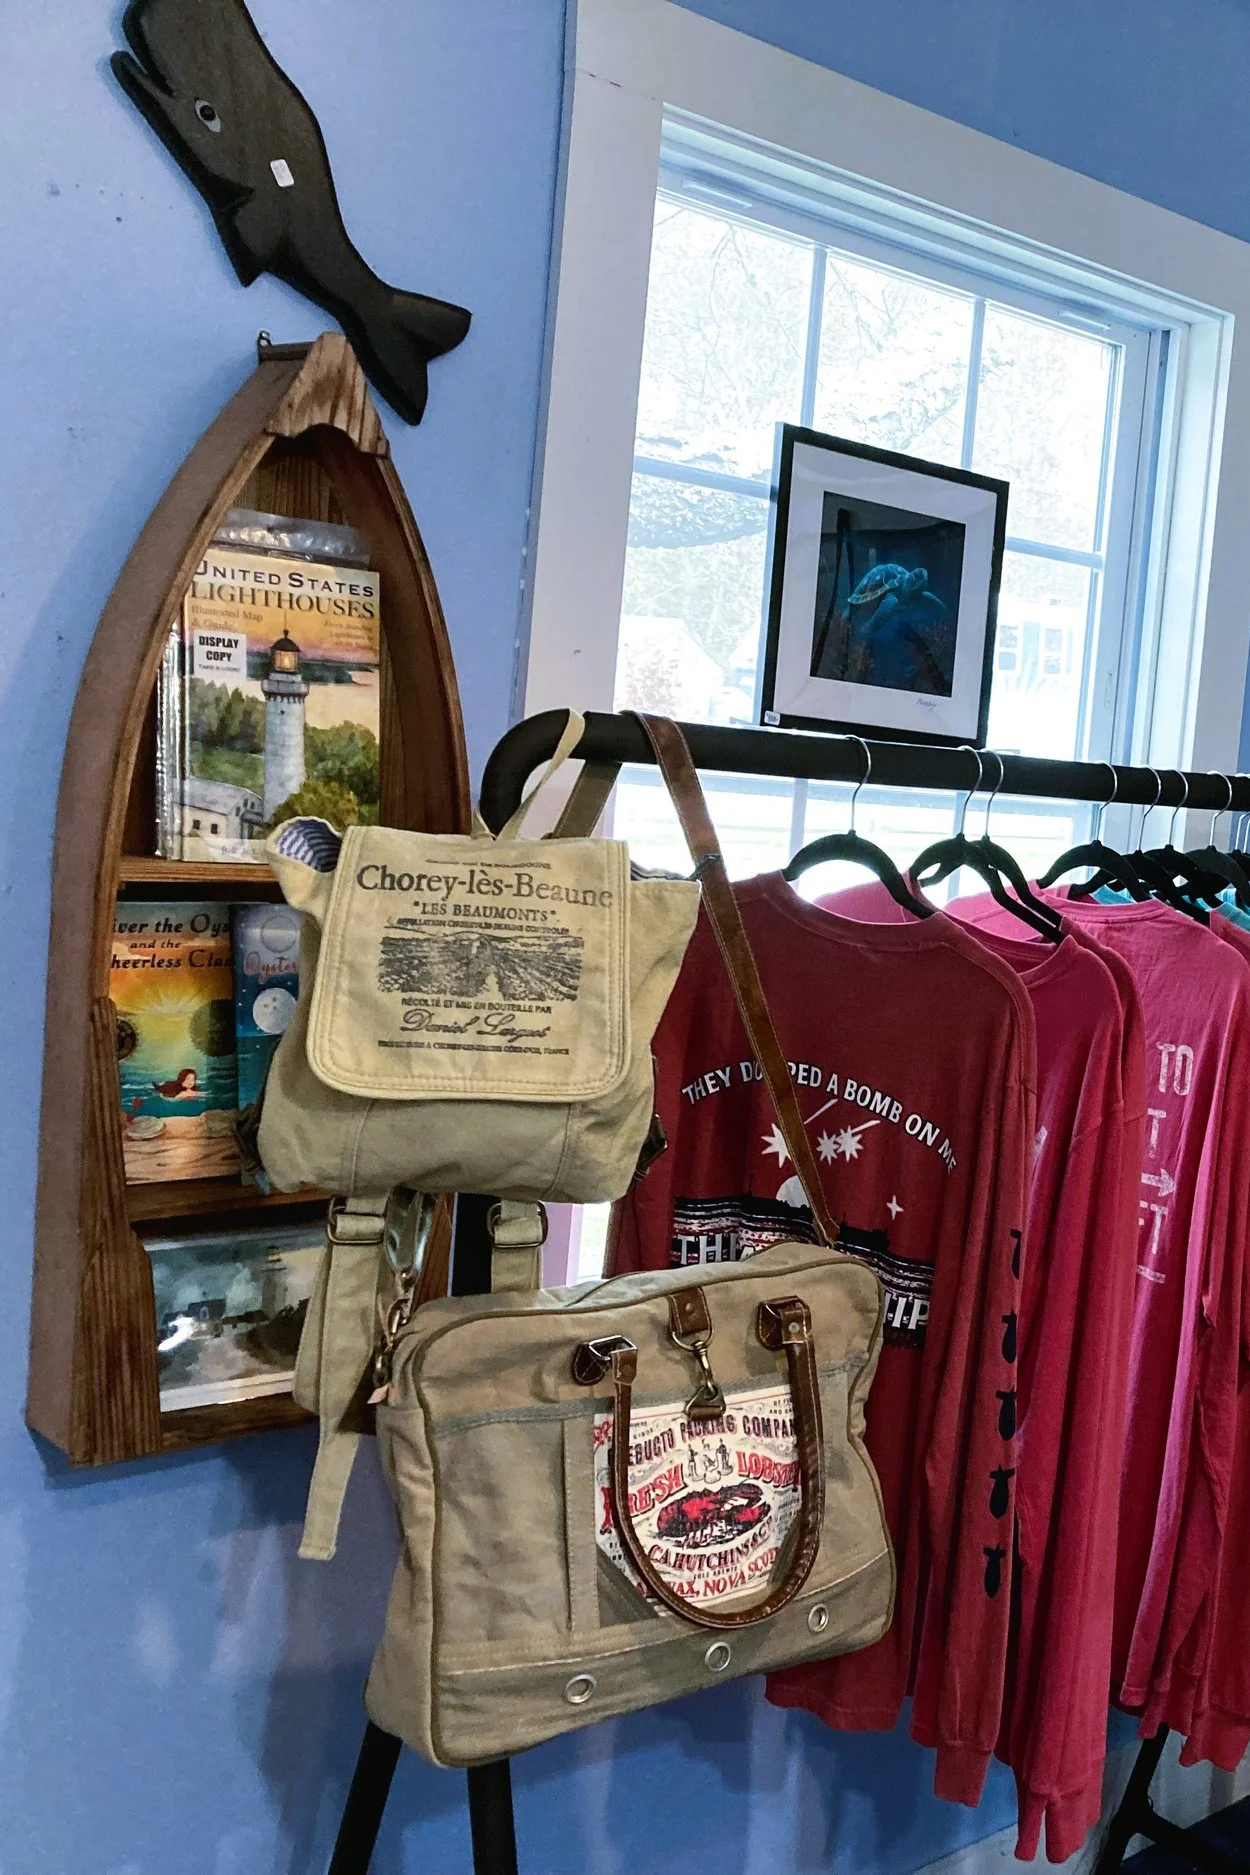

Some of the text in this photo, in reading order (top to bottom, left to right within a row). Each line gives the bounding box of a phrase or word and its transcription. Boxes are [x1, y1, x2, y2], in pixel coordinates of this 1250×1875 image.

[288, 572, 374, 597] STATES
[190, 581, 375, 619] LIGHTHOUSES
[242, 612, 263, 622] Map
[198, 635, 239, 649] DISPLAY
[206, 650, 232, 662] COPY
[356, 864, 614, 907] Chorey-lès-Beaune
[154, 915, 183, 934] the
[130, 938, 182, 950] and the
[1156, 1041, 1195, 1096] TO
[682, 1066, 733, 1105] THEY
[826, 1073, 839, 1096] A
[843, 1078, 904, 1125] BOMB
[904, 1113, 941, 1147] ON
[937, 1137, 959, 1176] ME
[702, 1571, 747, 1597] NOVA
